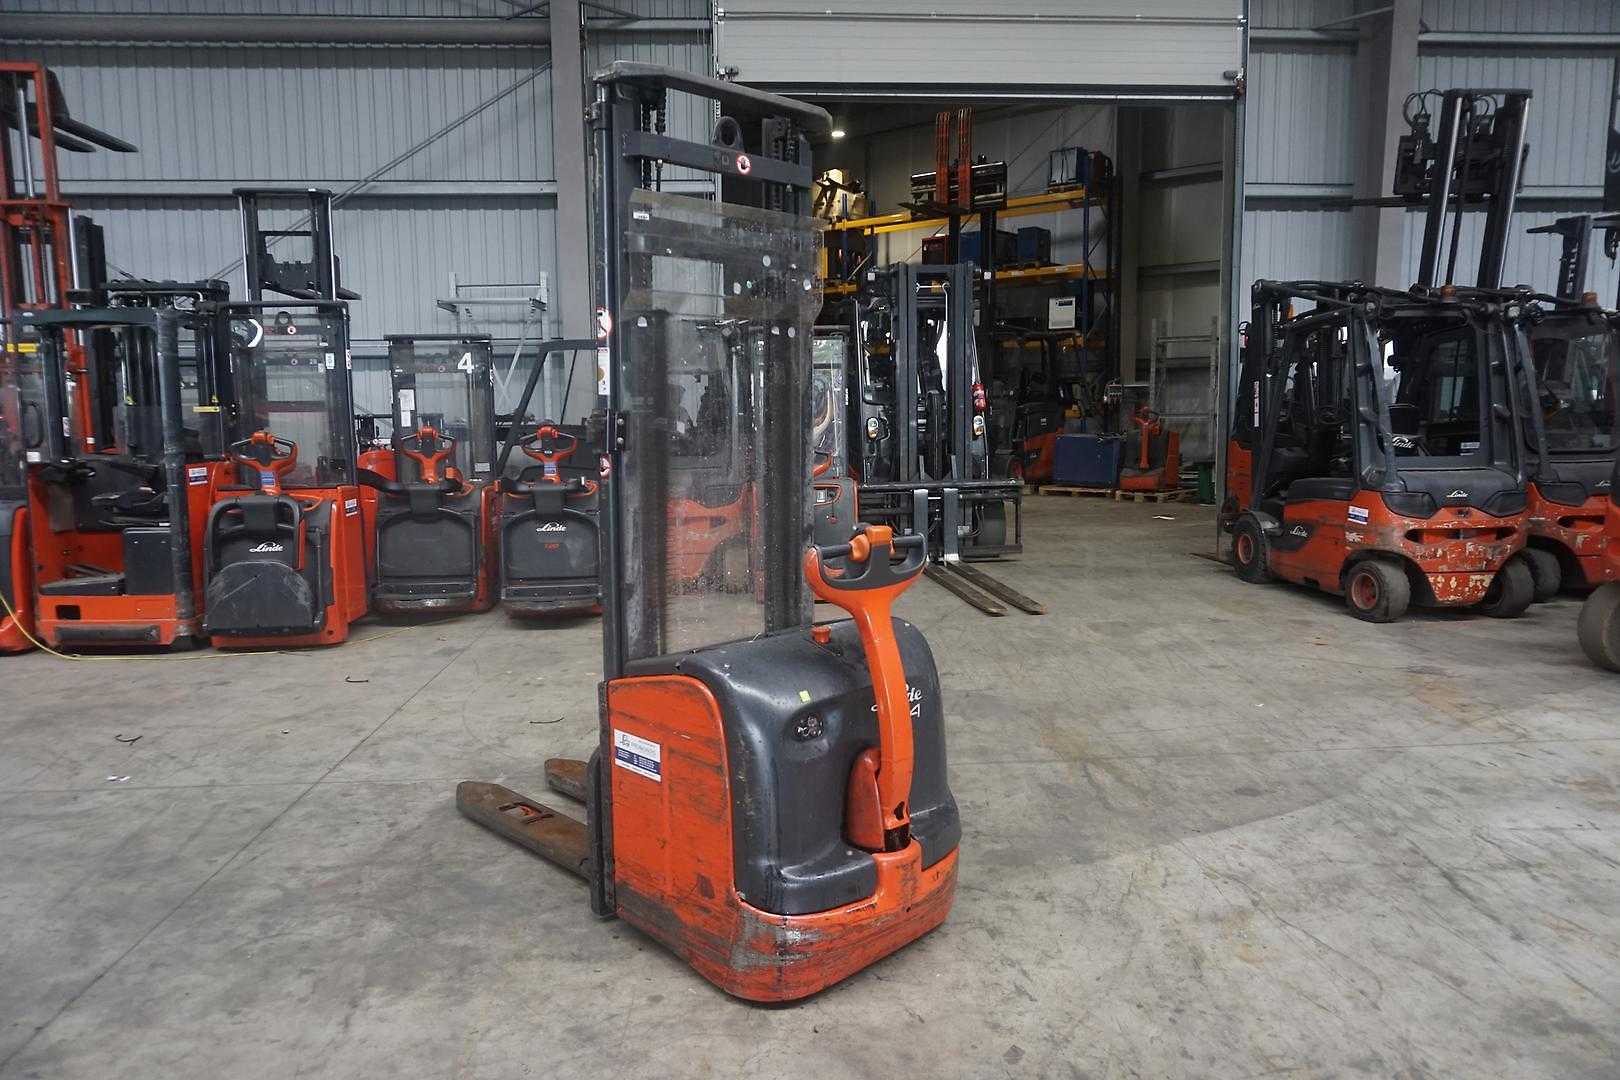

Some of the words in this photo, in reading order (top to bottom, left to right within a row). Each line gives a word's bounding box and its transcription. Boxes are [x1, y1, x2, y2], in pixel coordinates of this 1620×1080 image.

[457, 352, 475, 374] 4
[1446, 489, 1469, 498] Linde
[536, 521, 567, 532] Linde
[249, 541, 284, 553] Linde
